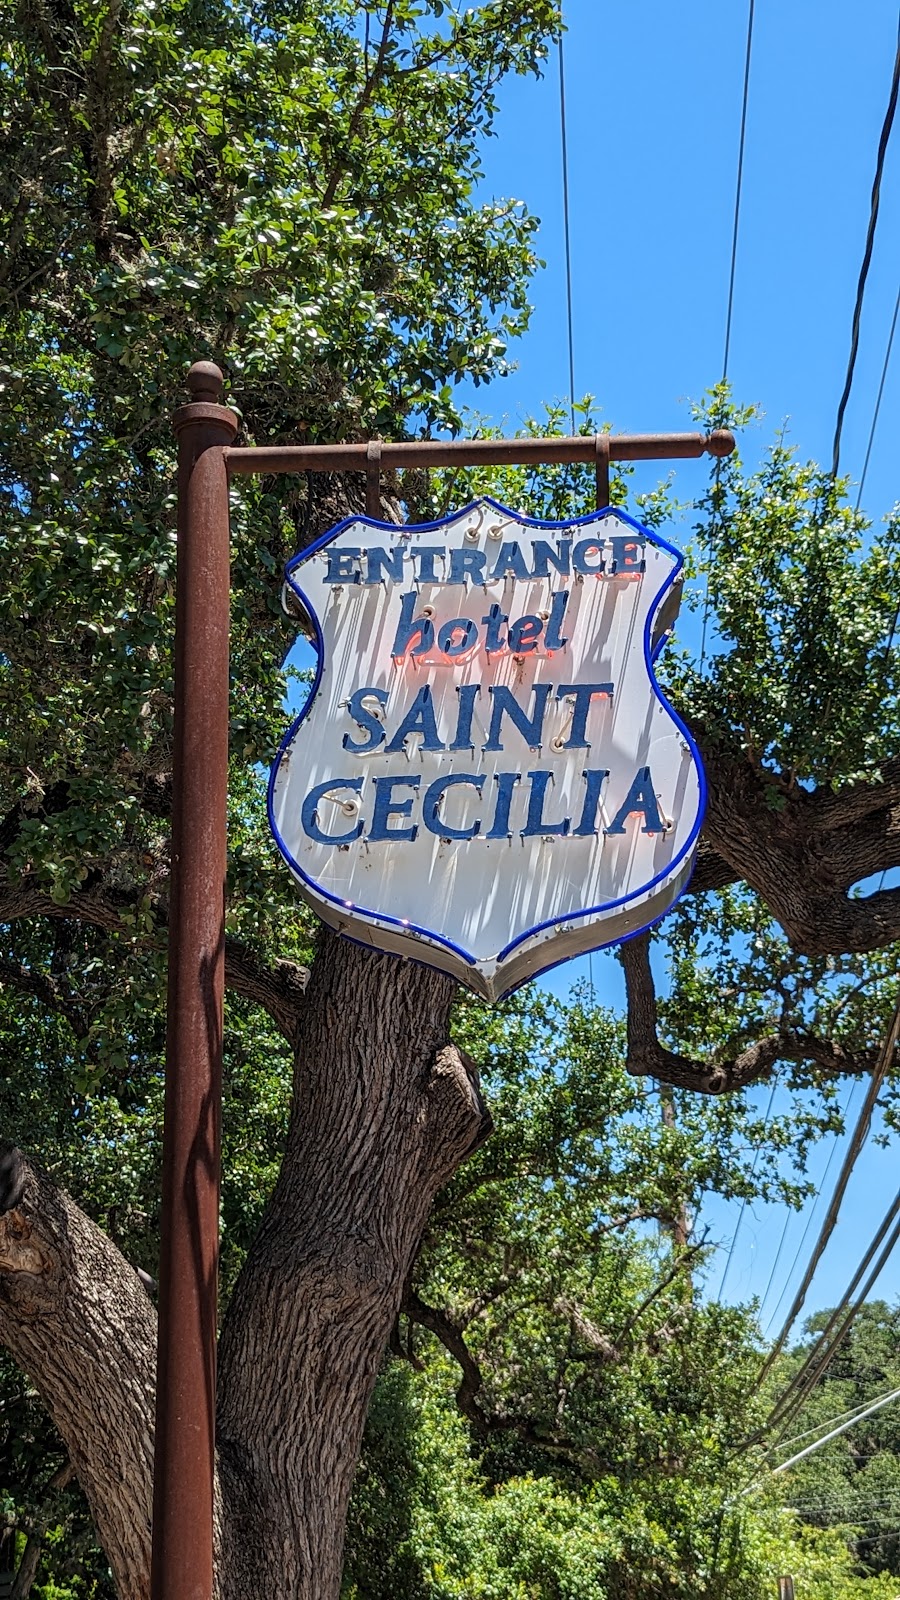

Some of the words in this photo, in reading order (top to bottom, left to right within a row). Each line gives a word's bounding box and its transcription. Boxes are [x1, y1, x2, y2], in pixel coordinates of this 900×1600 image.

[322, 535, 647, 586] ENTRANCE
[392, 590, 569, 657] hotel
[342, 682, 615, 753] SAINT
[301, 766, 665, 845] CECILIA
